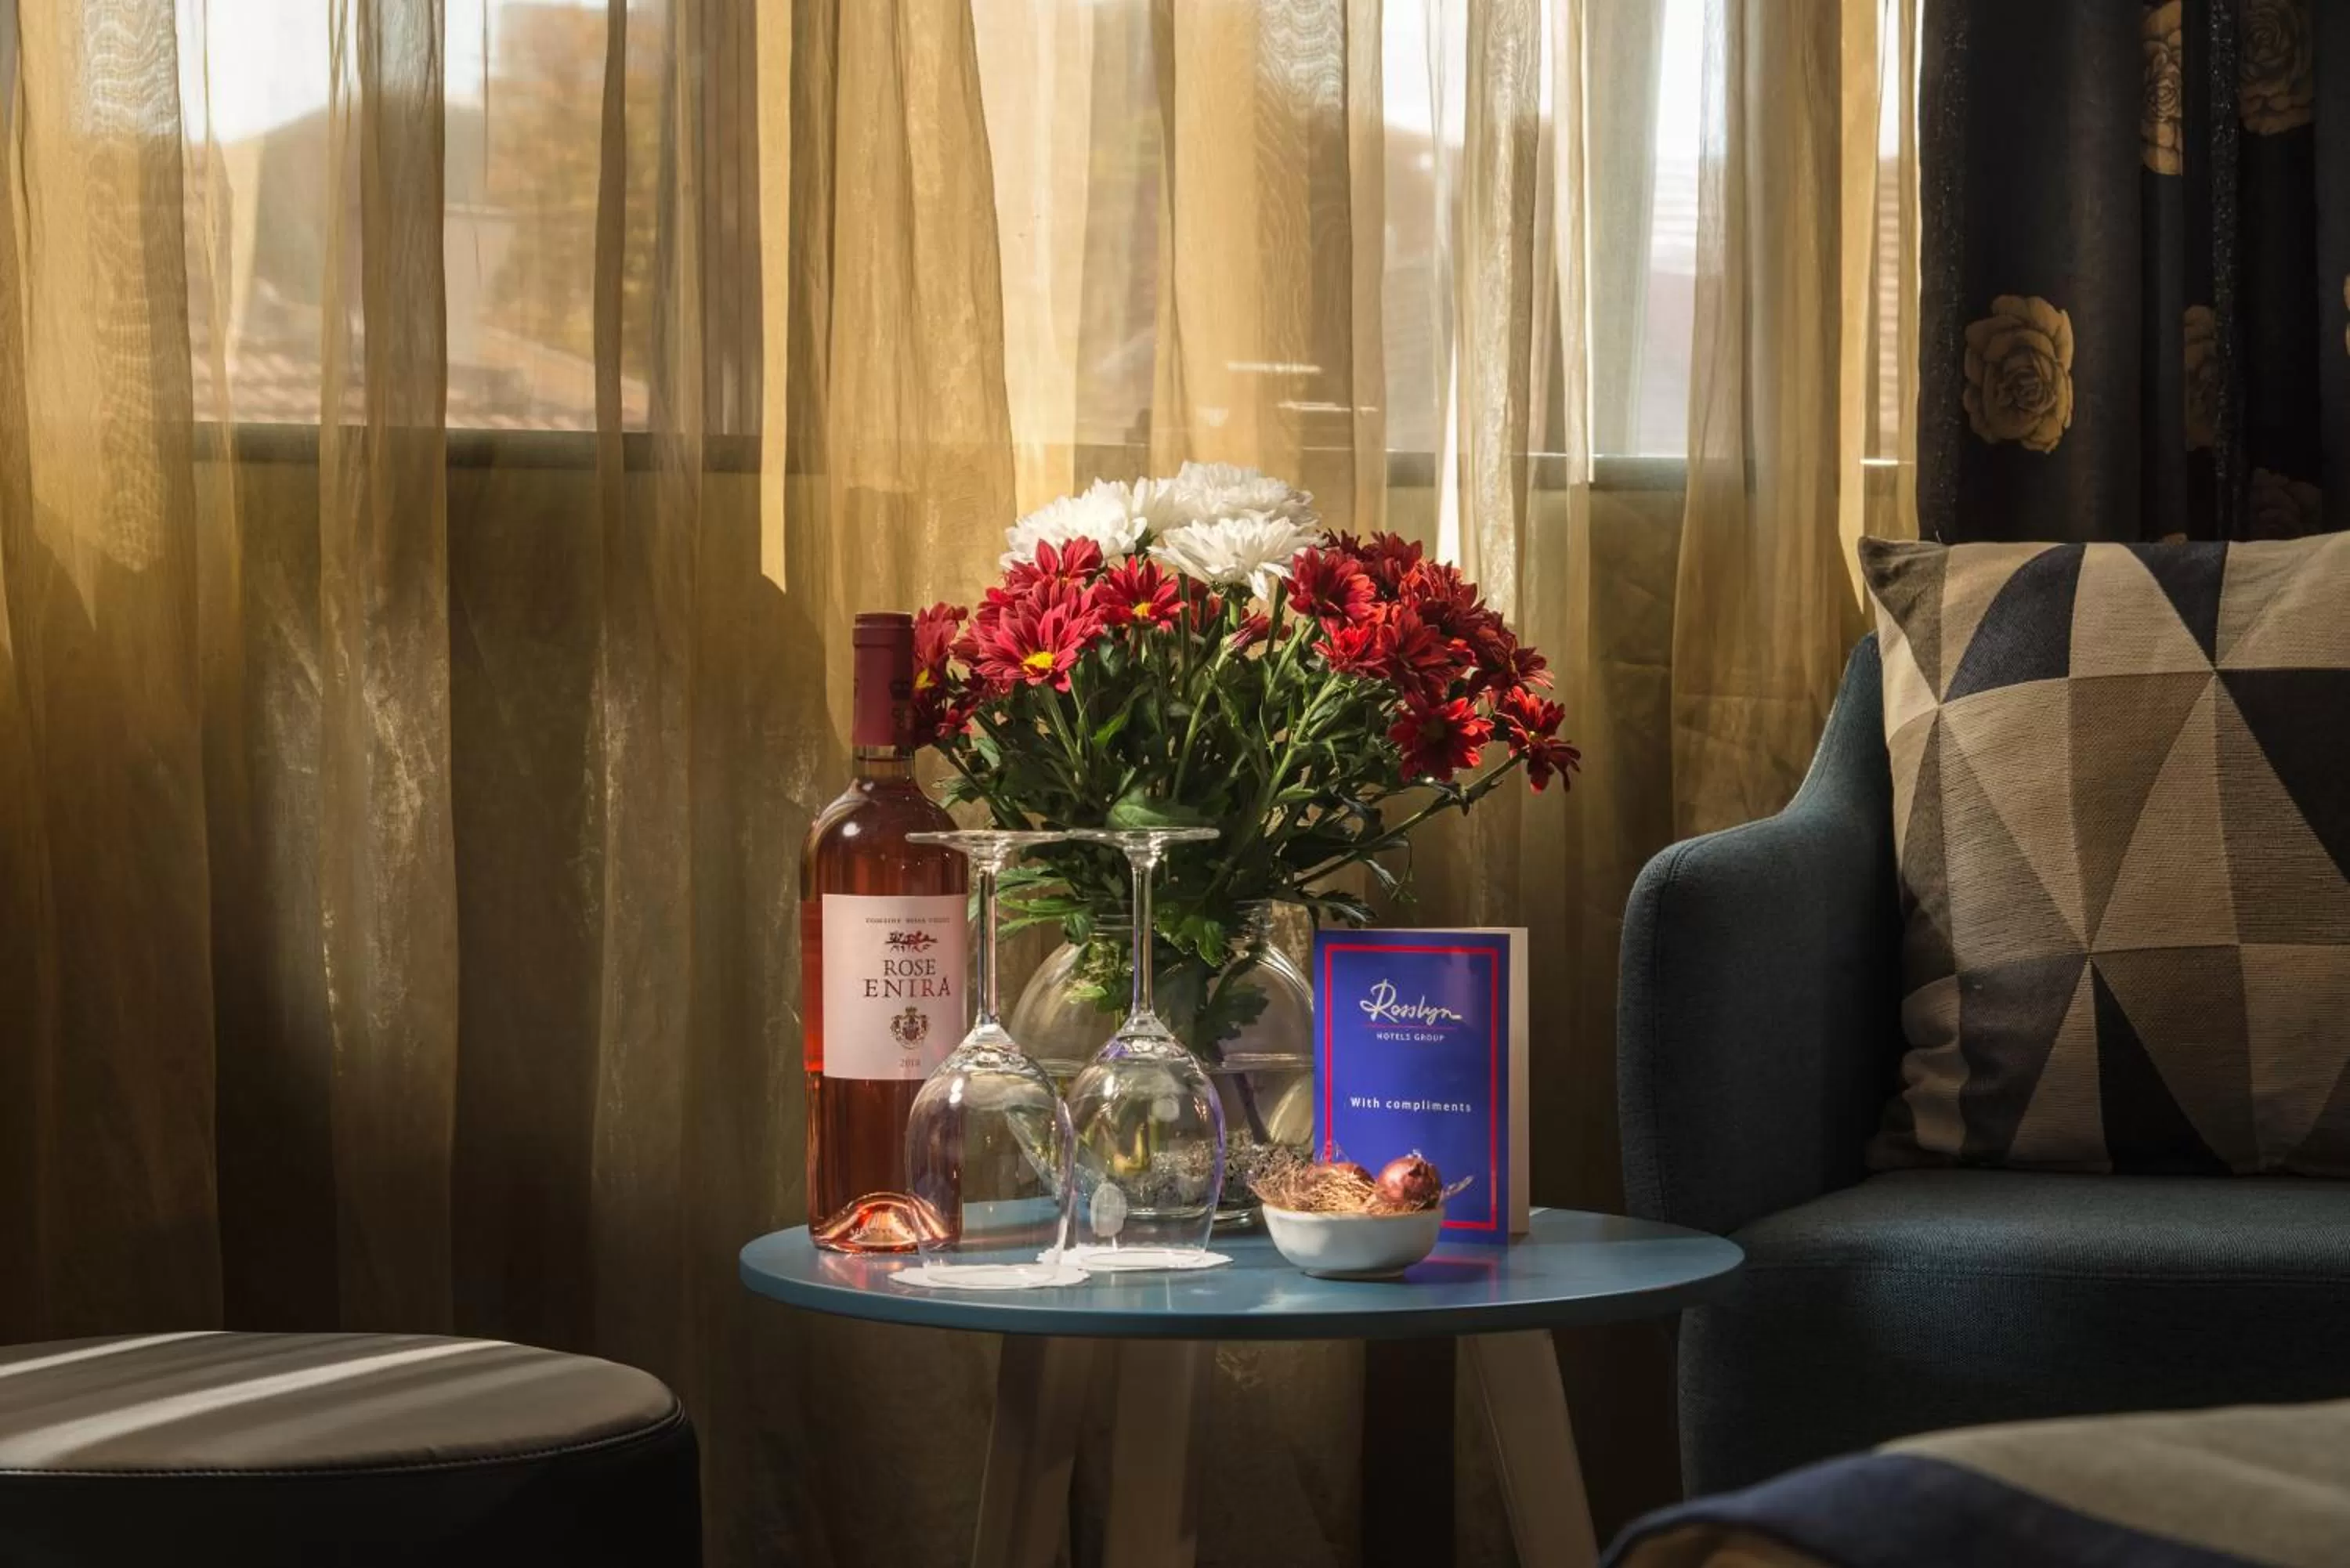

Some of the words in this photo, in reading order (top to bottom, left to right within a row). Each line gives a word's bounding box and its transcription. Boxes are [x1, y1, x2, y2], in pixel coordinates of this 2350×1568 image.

[864, 977, 951, 997] ENIRA
[1359, 978, 1462, 1026] Rosslyn
[1376, 1031, 1410, 1041] HOTELS
[1414, 1033, 1444, 1042] GROUP
[1350, 1097, 1379, 1108] With
[1386, 1100, 1471, 1113] compliments
